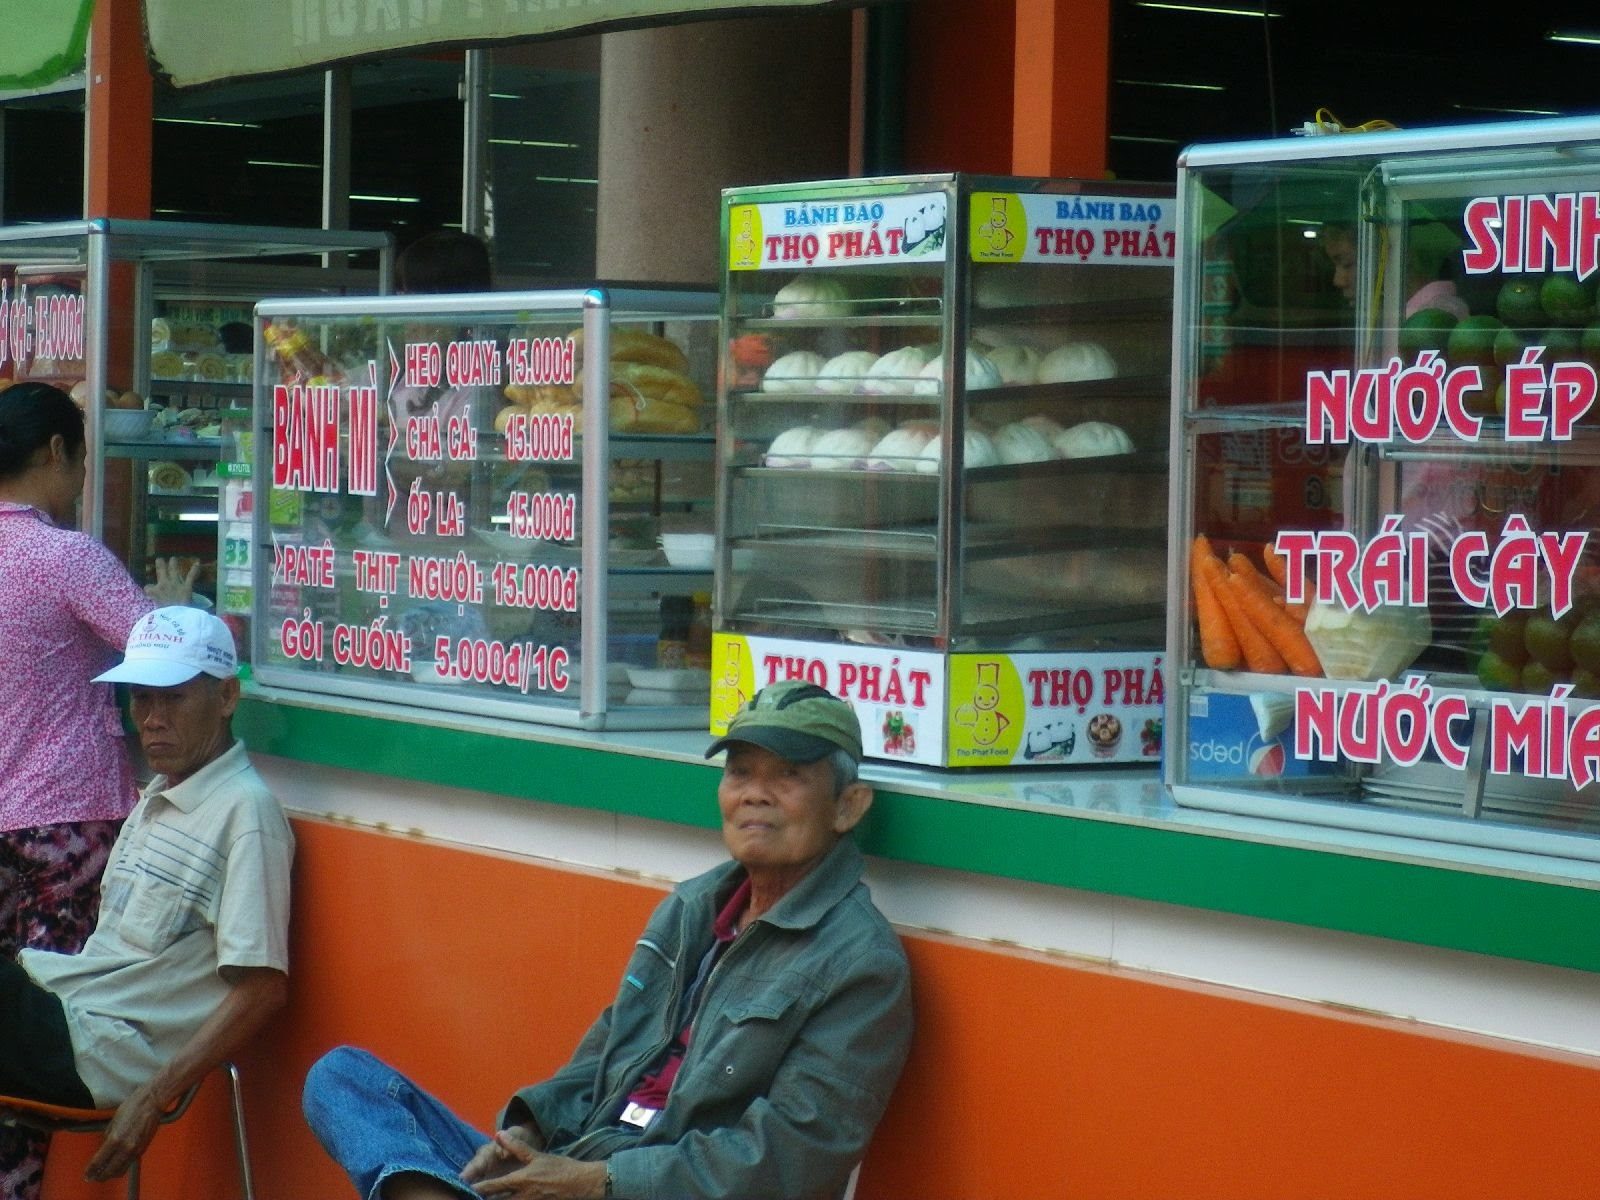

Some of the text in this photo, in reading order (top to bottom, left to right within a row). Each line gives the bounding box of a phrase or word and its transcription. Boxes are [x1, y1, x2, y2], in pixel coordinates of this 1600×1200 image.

[784, 199, 884, 227] BÁNH BAO
[1056, 196, 1162, 222] BÁNH BAO
[765, 222, 904, 266] THỌ PHÁT
[1035, 223, 1176, 263] THỌ PHÁT
[405, 337, 575, 390] HEO QUAY: 15.000đ
[1305, 346, 1599, 445] NƯỚC ÉP
[273, 360, 377, 497] BÁNH MÌ
[405, 401, 574, 461] CHẢ CÁ: 15.000đ
[407, 477, 575, 541] ỐP LA: 15.000đ
[284, 538, 578, 616] PATÊ THỊT NGUỘI: 15.000đ
[1275, 512, 1589, 620] TRÁI CÂY
[281, 606, 323, 661] GỎI
[332, 615, 411, 673] CUỐN:
[434, 635, 569, 694] 5.000đ/1C
[838, 657, 933, 707] PHÁT
[1029, 657, 1165, 714] THỌ PHÁ
[1189, 739, 1243, 764] peps
[1295, 675, 1600, 792] NƯỚC MÍA
